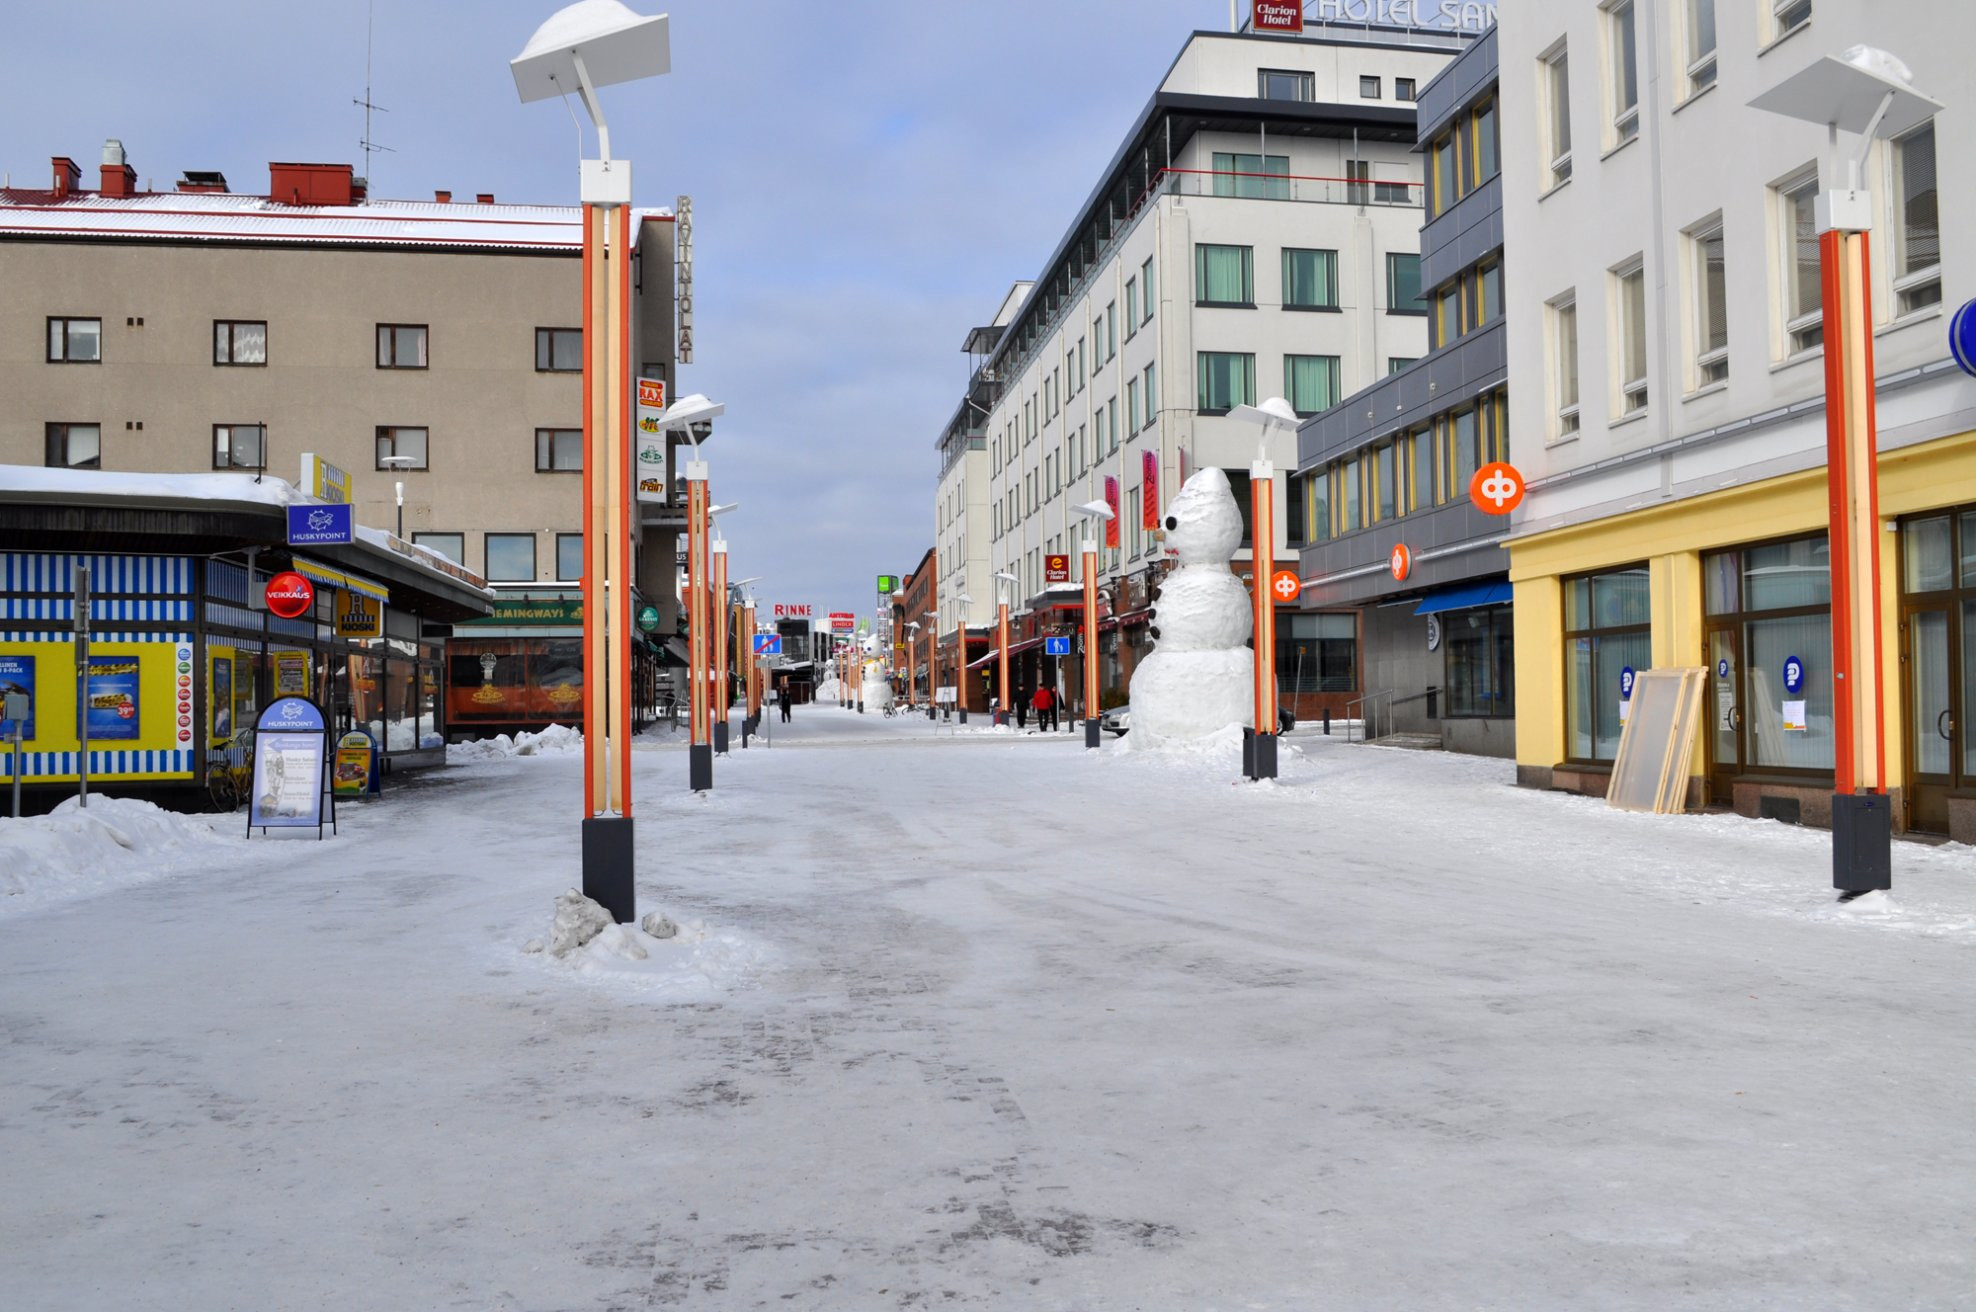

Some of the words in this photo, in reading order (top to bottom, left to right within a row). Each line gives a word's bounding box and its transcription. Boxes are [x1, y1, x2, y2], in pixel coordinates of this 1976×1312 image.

[1256, 4, 1297, 16] Clarion
[1263, 15, 1292, 26] Hotel
[678, 195, 693, 363] RAVINTOLAT
[639, 387, 664, 402] RAX
[292, 532, 347, 541] HUSKYPOINT
[266, 591, 310, 599] VEIKKAUS
[774, 604, 812, 616] RINNE
[341, 623, 375, 632] KIOSKI
